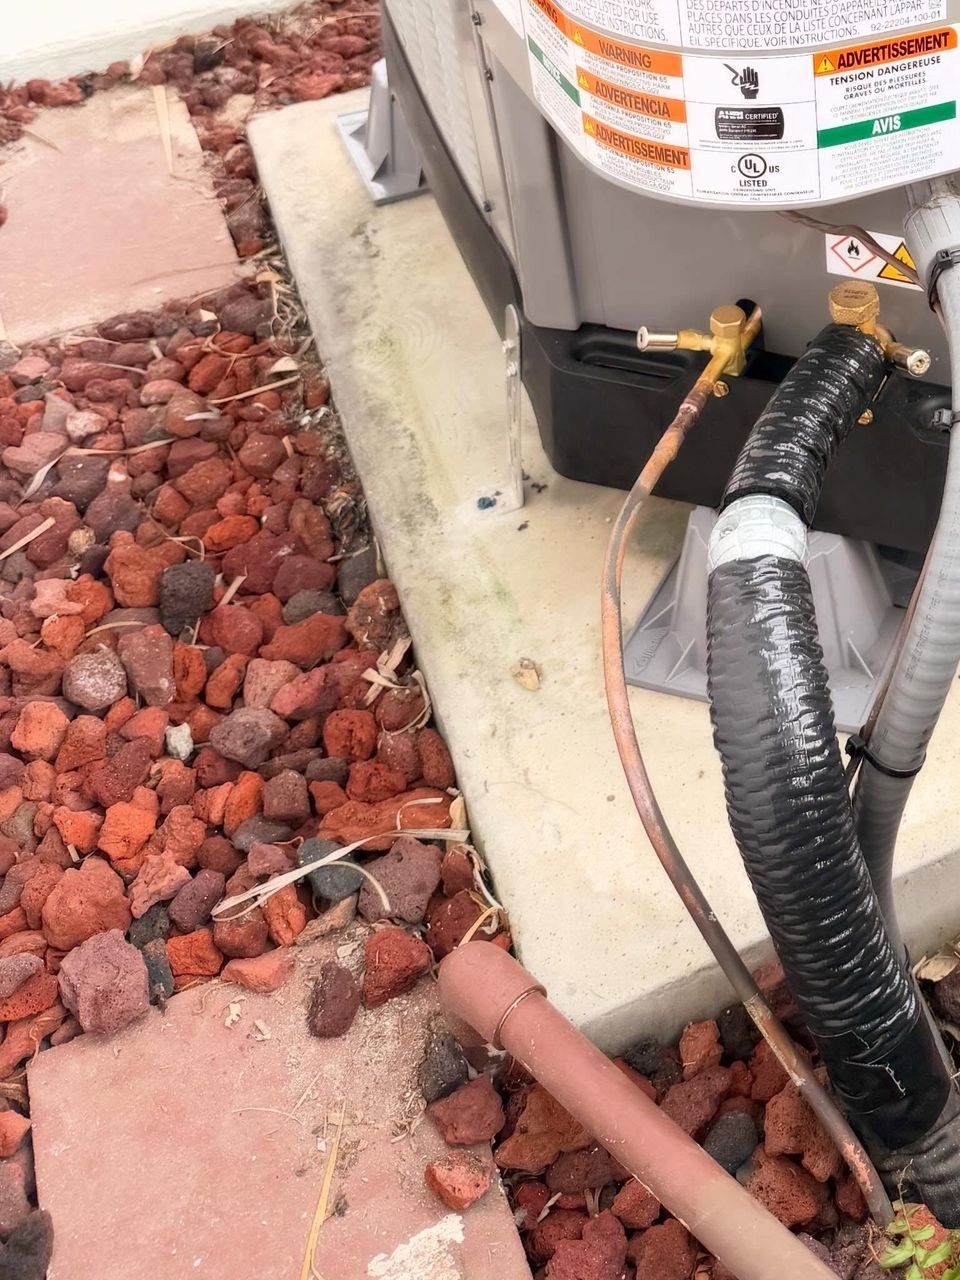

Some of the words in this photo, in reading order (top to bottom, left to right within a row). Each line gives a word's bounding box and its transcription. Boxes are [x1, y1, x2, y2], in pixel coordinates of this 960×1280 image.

[686, 0, 705, 10] DES
[724, 12, 752, 24] DANS
[754, 11, 771, 23] LES
[773, 4, 829, 23] CONDUITES
[624, 6, 641, 21] FOR
[641, 12, 659, 26] USE
[688, 23, 722, 35] AUTRES
[724, 24, 745, 37] QUE
[746, 22, 772, 36] CEUX
[774, 22, 787, 35] DE
[789, 21, 801, 33] LA
[803, 19, 826, 32] LISTE
[828, 9, 888, 29] CONCERNANT
[689, 35, 702, 46] EIL
[764, 35, 788, 47] VOIR
[789, 26, 861, 46] INSTRUCTIONS.
[870, 9, 942, 32] 92-22204-100-01
[598, 39, 653, 69] WARNING
[837, 31, 950, 70] ADVERTISSEMENT
[616, 64, 659, 81] PROPOSITION
[659, 75, 668, 83] 65
[830, 70, 874, 86] TENSION
[877, 55, 942, 77] DANGEREUSE
[845, 83, 872, 94] RISQUE
[874, 80, 887, 88] DES
[889, 71, 926, 84] BLESSURES
[594, 81, 671, 118] ADVERTENCIA
[843, 89, 872, 101] GRAVES
[874, 87, 886, 95] OU
[621, 109, 662, 127] PROPOSITION
[663, 120, 672, 128] 65
[872, 115, 902, 135] AVIS
[594, 124, 689, 167] ADVERTISSEMENT
[626, 154, 666, 173] PROPOSITION
[667, 166, 675, 174] 65
[744, 159, 760, 173] UL
[768, 165, 780, 173] US
[739, 179, 768, 187] LISTED
